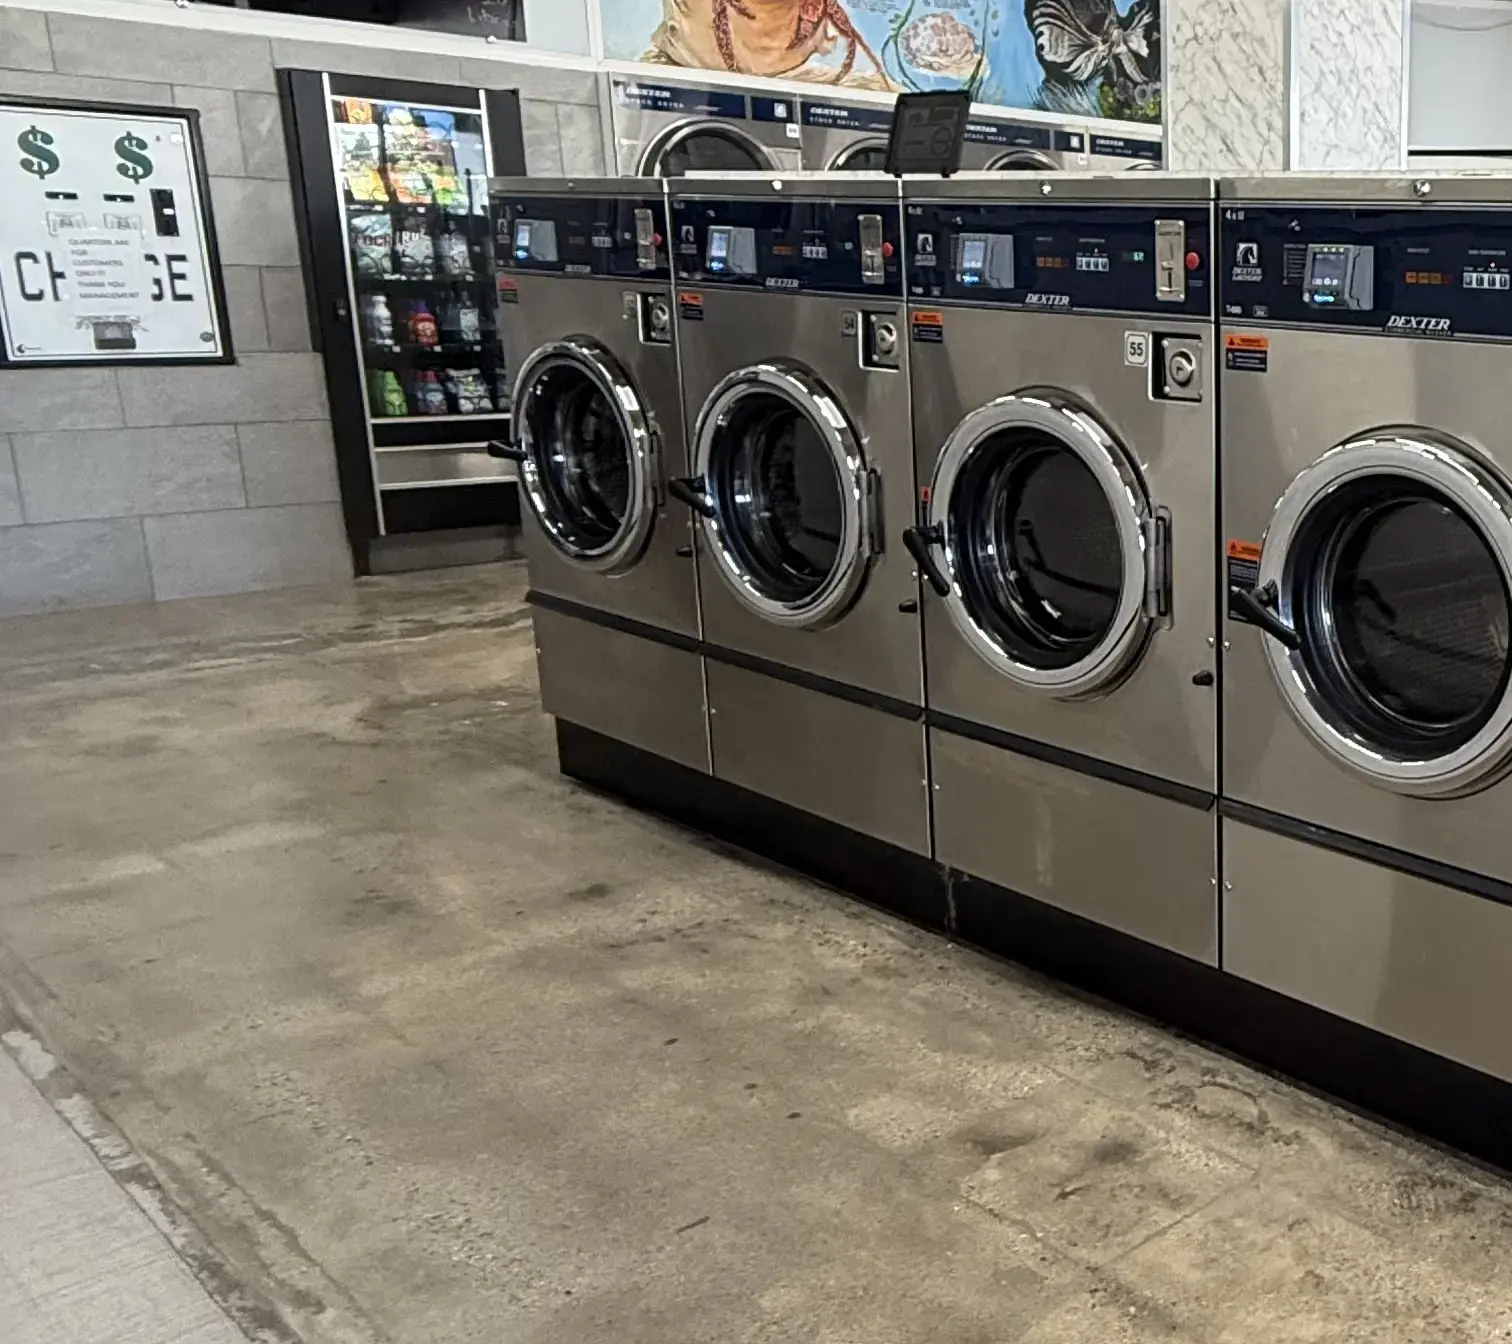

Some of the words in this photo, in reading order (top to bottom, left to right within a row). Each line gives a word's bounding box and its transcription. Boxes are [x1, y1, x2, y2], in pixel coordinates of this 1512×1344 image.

[14, 250, 194, 302] CHGE
[1025, 293, 1070, 306] DEXTER
[1387, 315, 1451, 331] DEXTER
[1129, 342, 1145, 357] 55
